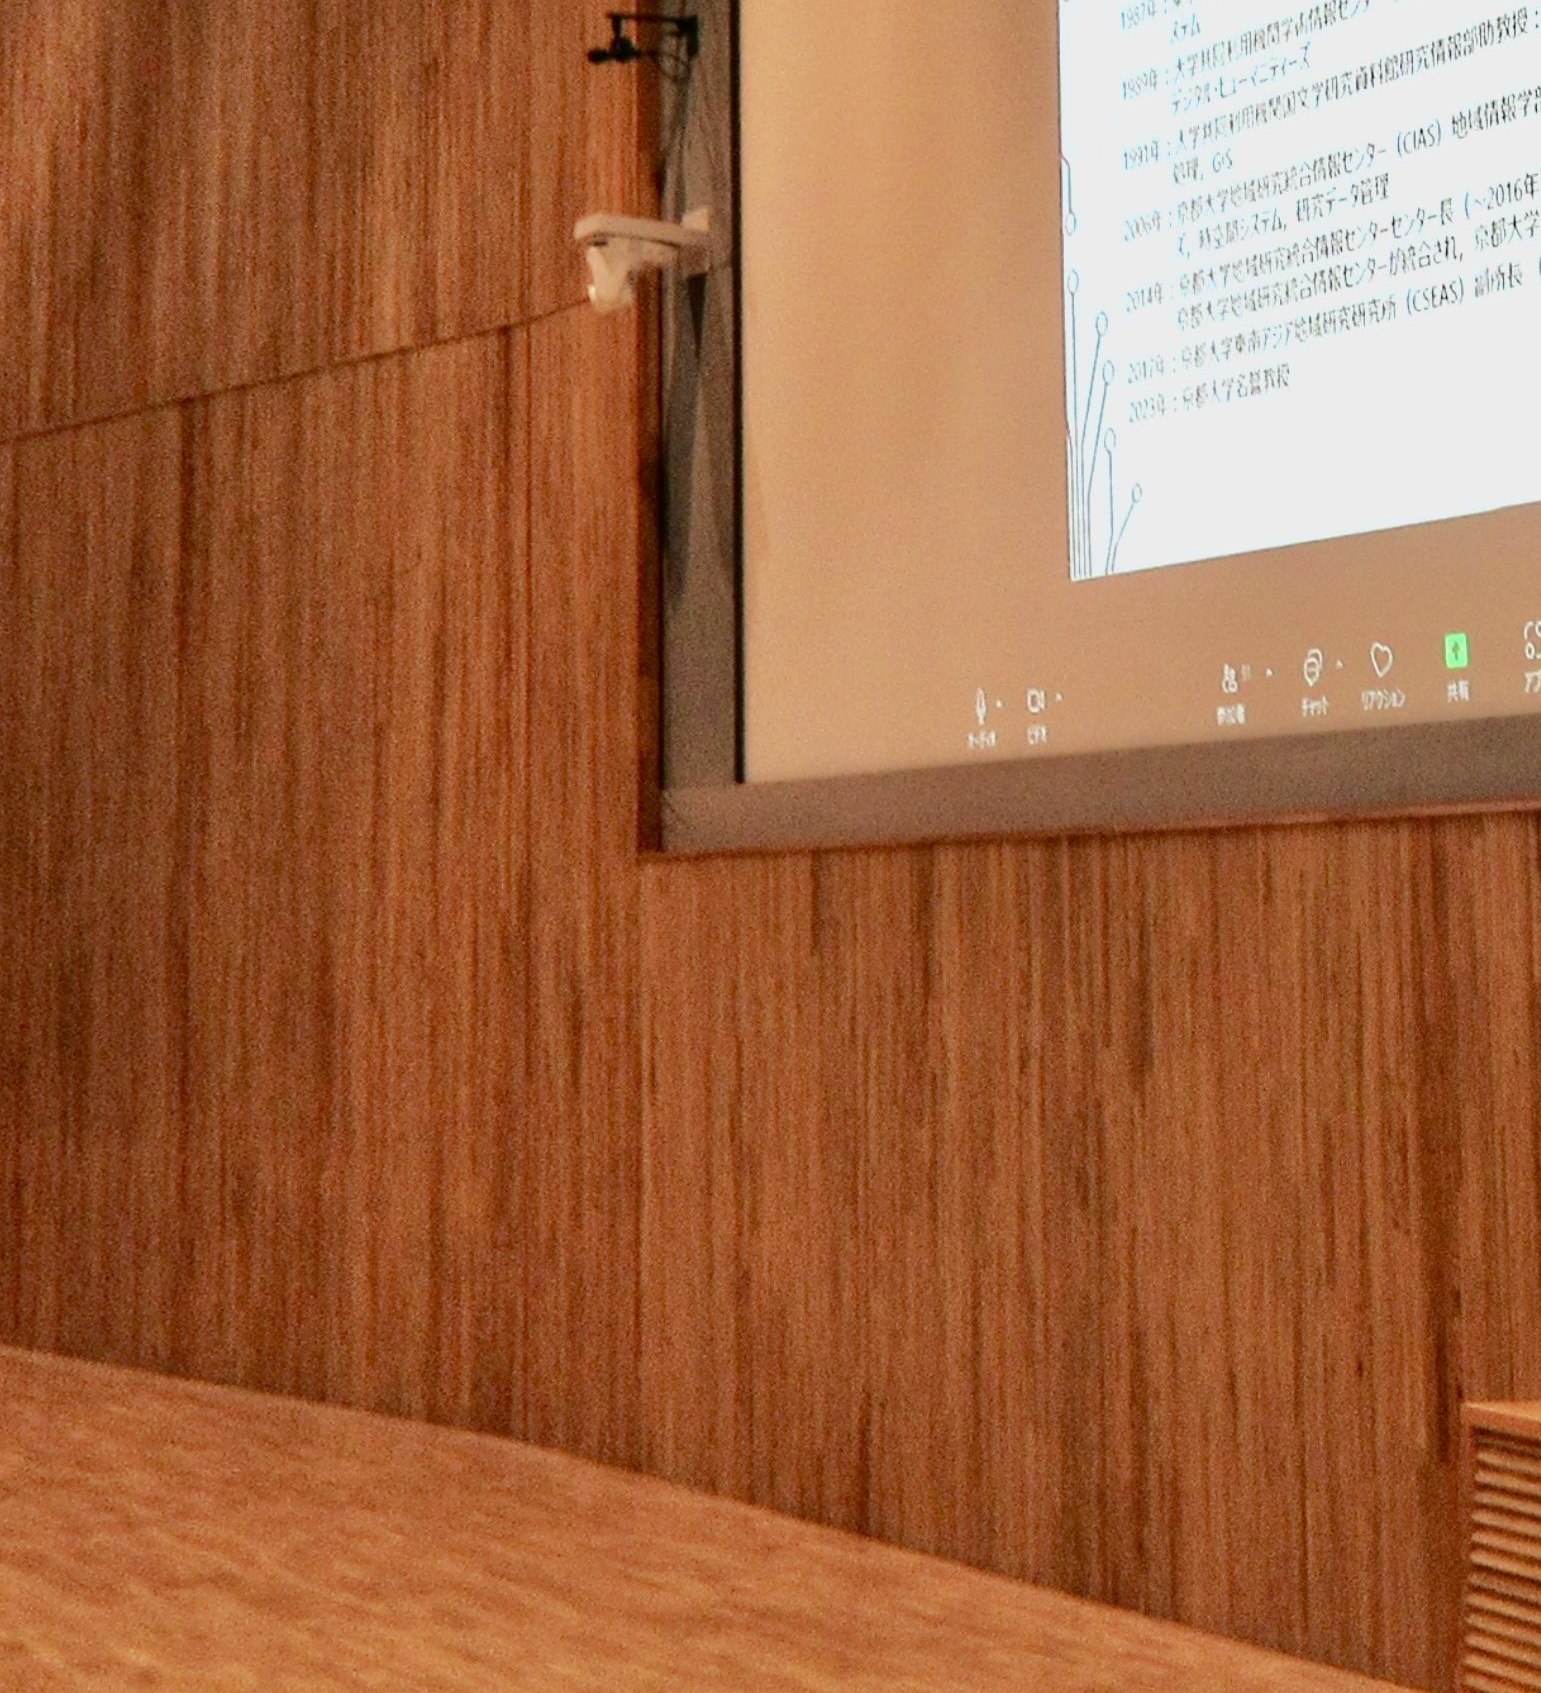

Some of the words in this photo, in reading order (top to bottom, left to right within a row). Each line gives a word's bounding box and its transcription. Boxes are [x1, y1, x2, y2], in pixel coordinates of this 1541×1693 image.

[1361, 689, 1406, 711] リアクション
